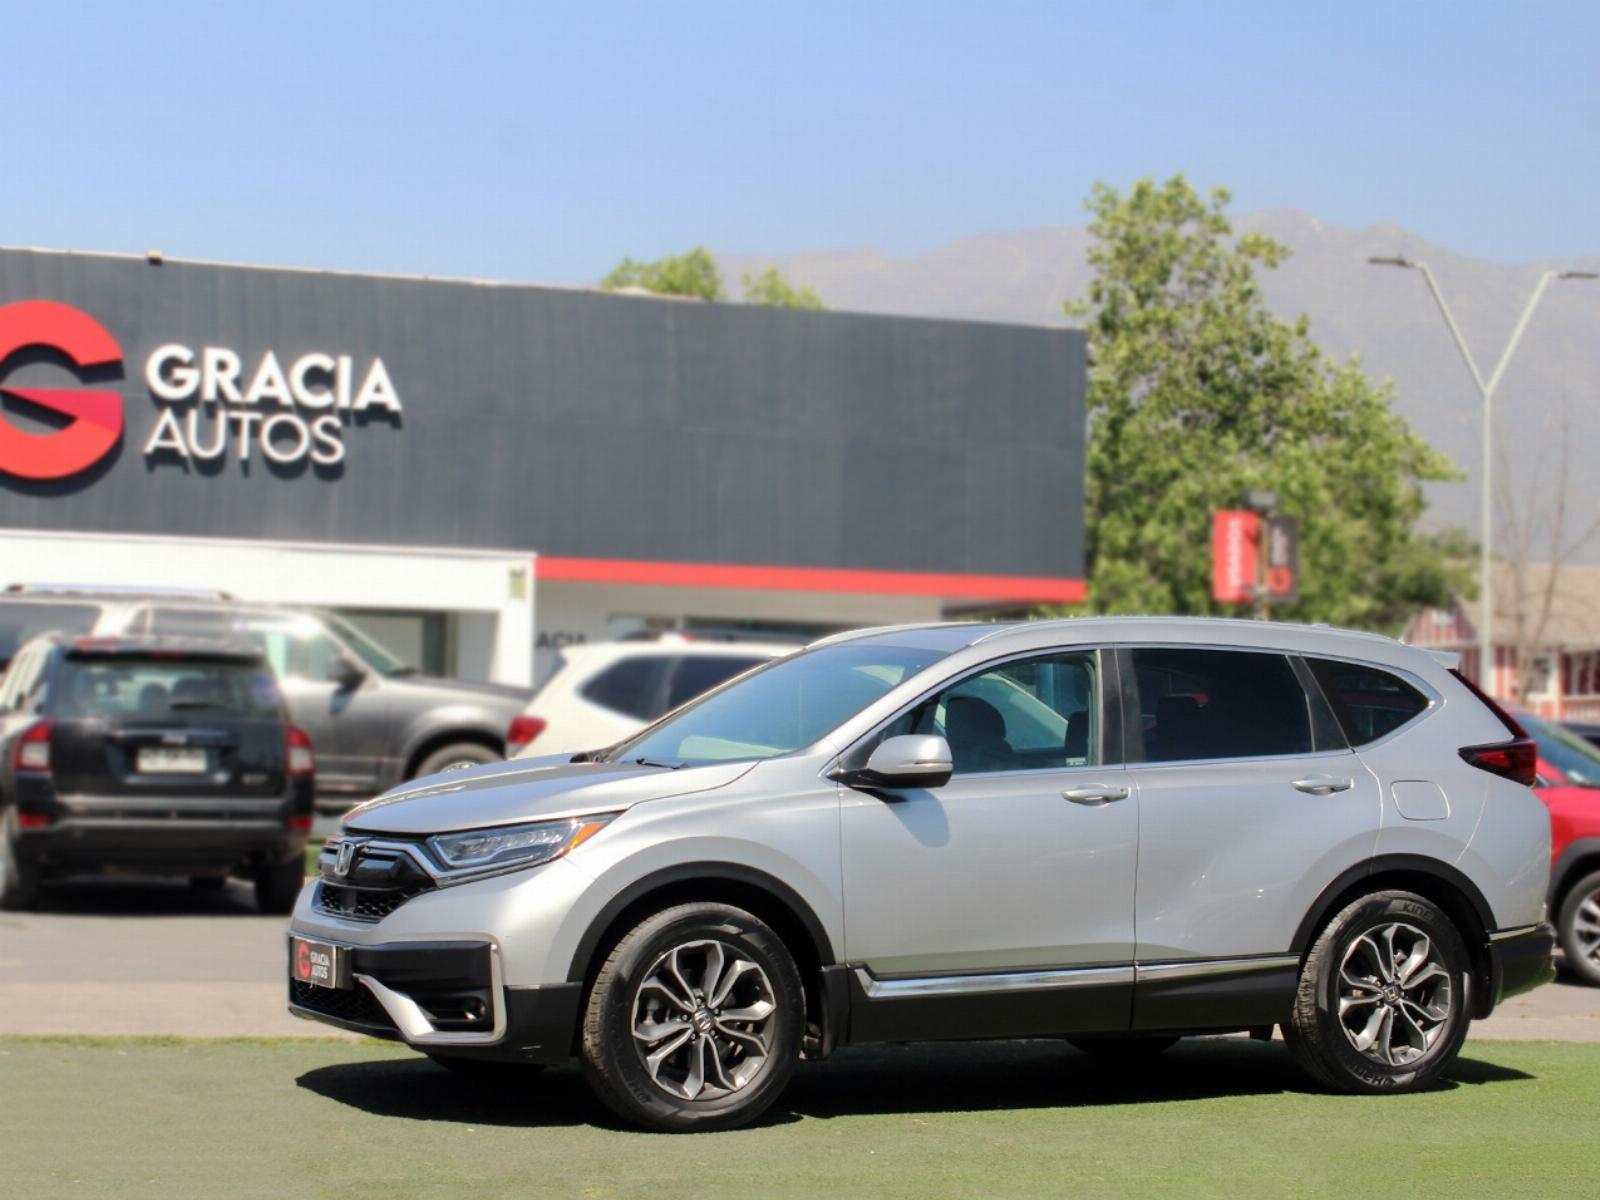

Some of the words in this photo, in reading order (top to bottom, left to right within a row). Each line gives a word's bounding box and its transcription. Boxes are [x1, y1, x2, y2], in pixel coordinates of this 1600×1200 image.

[145, 344, 402, 412] GRACIA
[144, 408, 345, 464] AUTOS
[535, 631, 587, 648] ACIA
